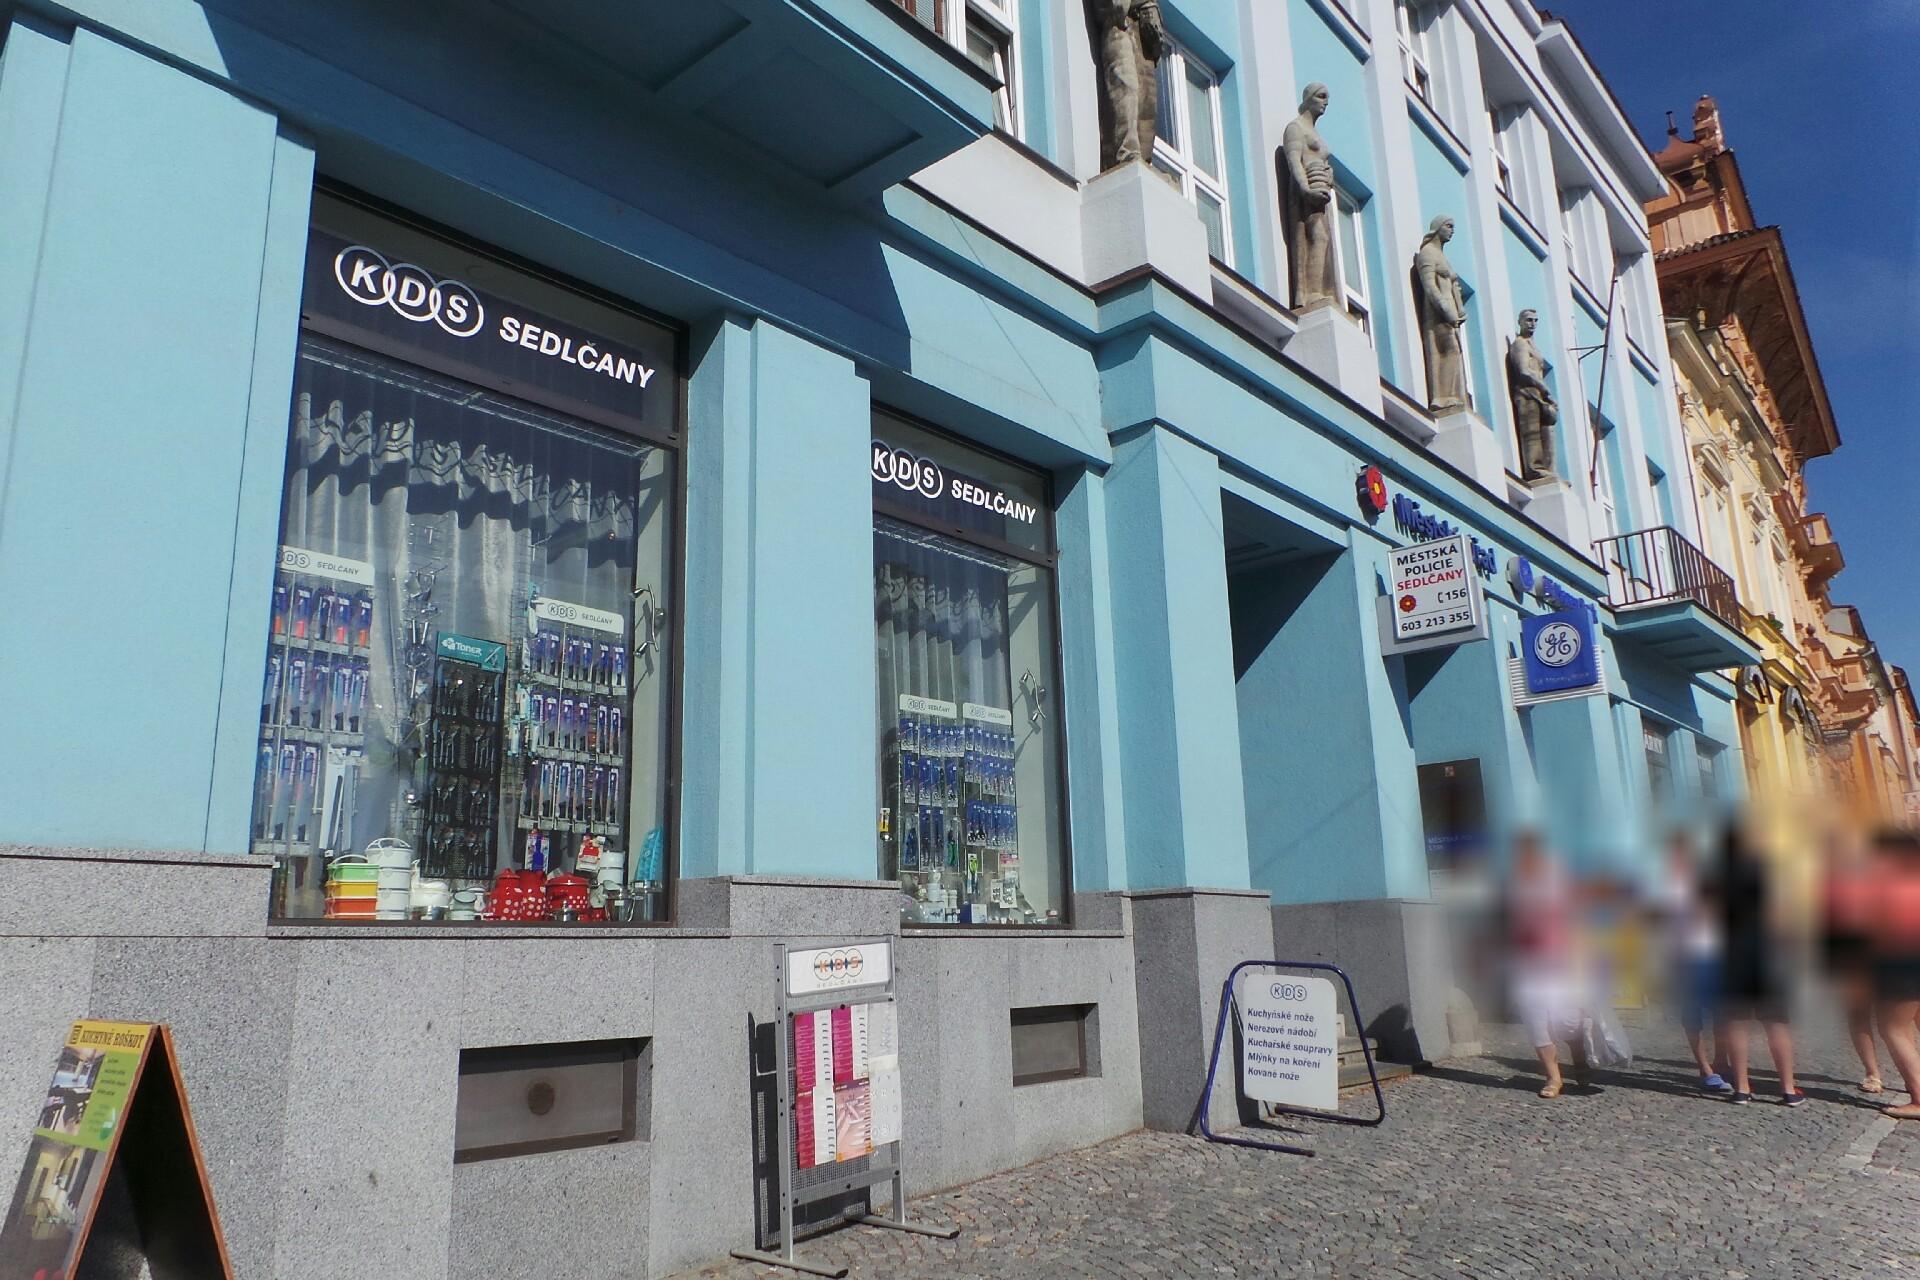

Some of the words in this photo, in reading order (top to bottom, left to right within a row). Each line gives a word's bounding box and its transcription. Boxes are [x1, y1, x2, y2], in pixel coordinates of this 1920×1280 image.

[350, 256, 470, 324] KDS
[499, 315, 656, 389] SEDLČANY
[951, 479, 1037, 524] SEDLČANY
[1396, 542, 1459, 566] MĚSTSKÁ
[1404, 558, 1454, 577] POLICIE
[1397, 568, 1464, 592] SEDLČANY
[1445, 588, 1467, 600] 156
[549, 604, 575, 618] KDS
[1401, 620, 1422, 631] 603
[1425, 616, 1446, 627] 213
[1449, 611, 1470, 623] 355
[1272, 985, 1305, 999] KDS
[1247, 1007, 1291, 1020] Kuchyňské
[1294, 1012, 1314, 1022] nože
[1247, 1023, 1285, 1035] Nerezové
[1287, 1027, 1318, 1038] nádobí
[1247, 1037, 1291, 1050] Kuchařské
[1293, 1043, 1333, 1056] soupravy
[1247, 1052, 1277, 1064] Mlýnky
[1279, 1057, 1290, 1065] na
[1292, 1055, 1321, 1069] koření
[1279, 1071, 1300, 1081] nože
